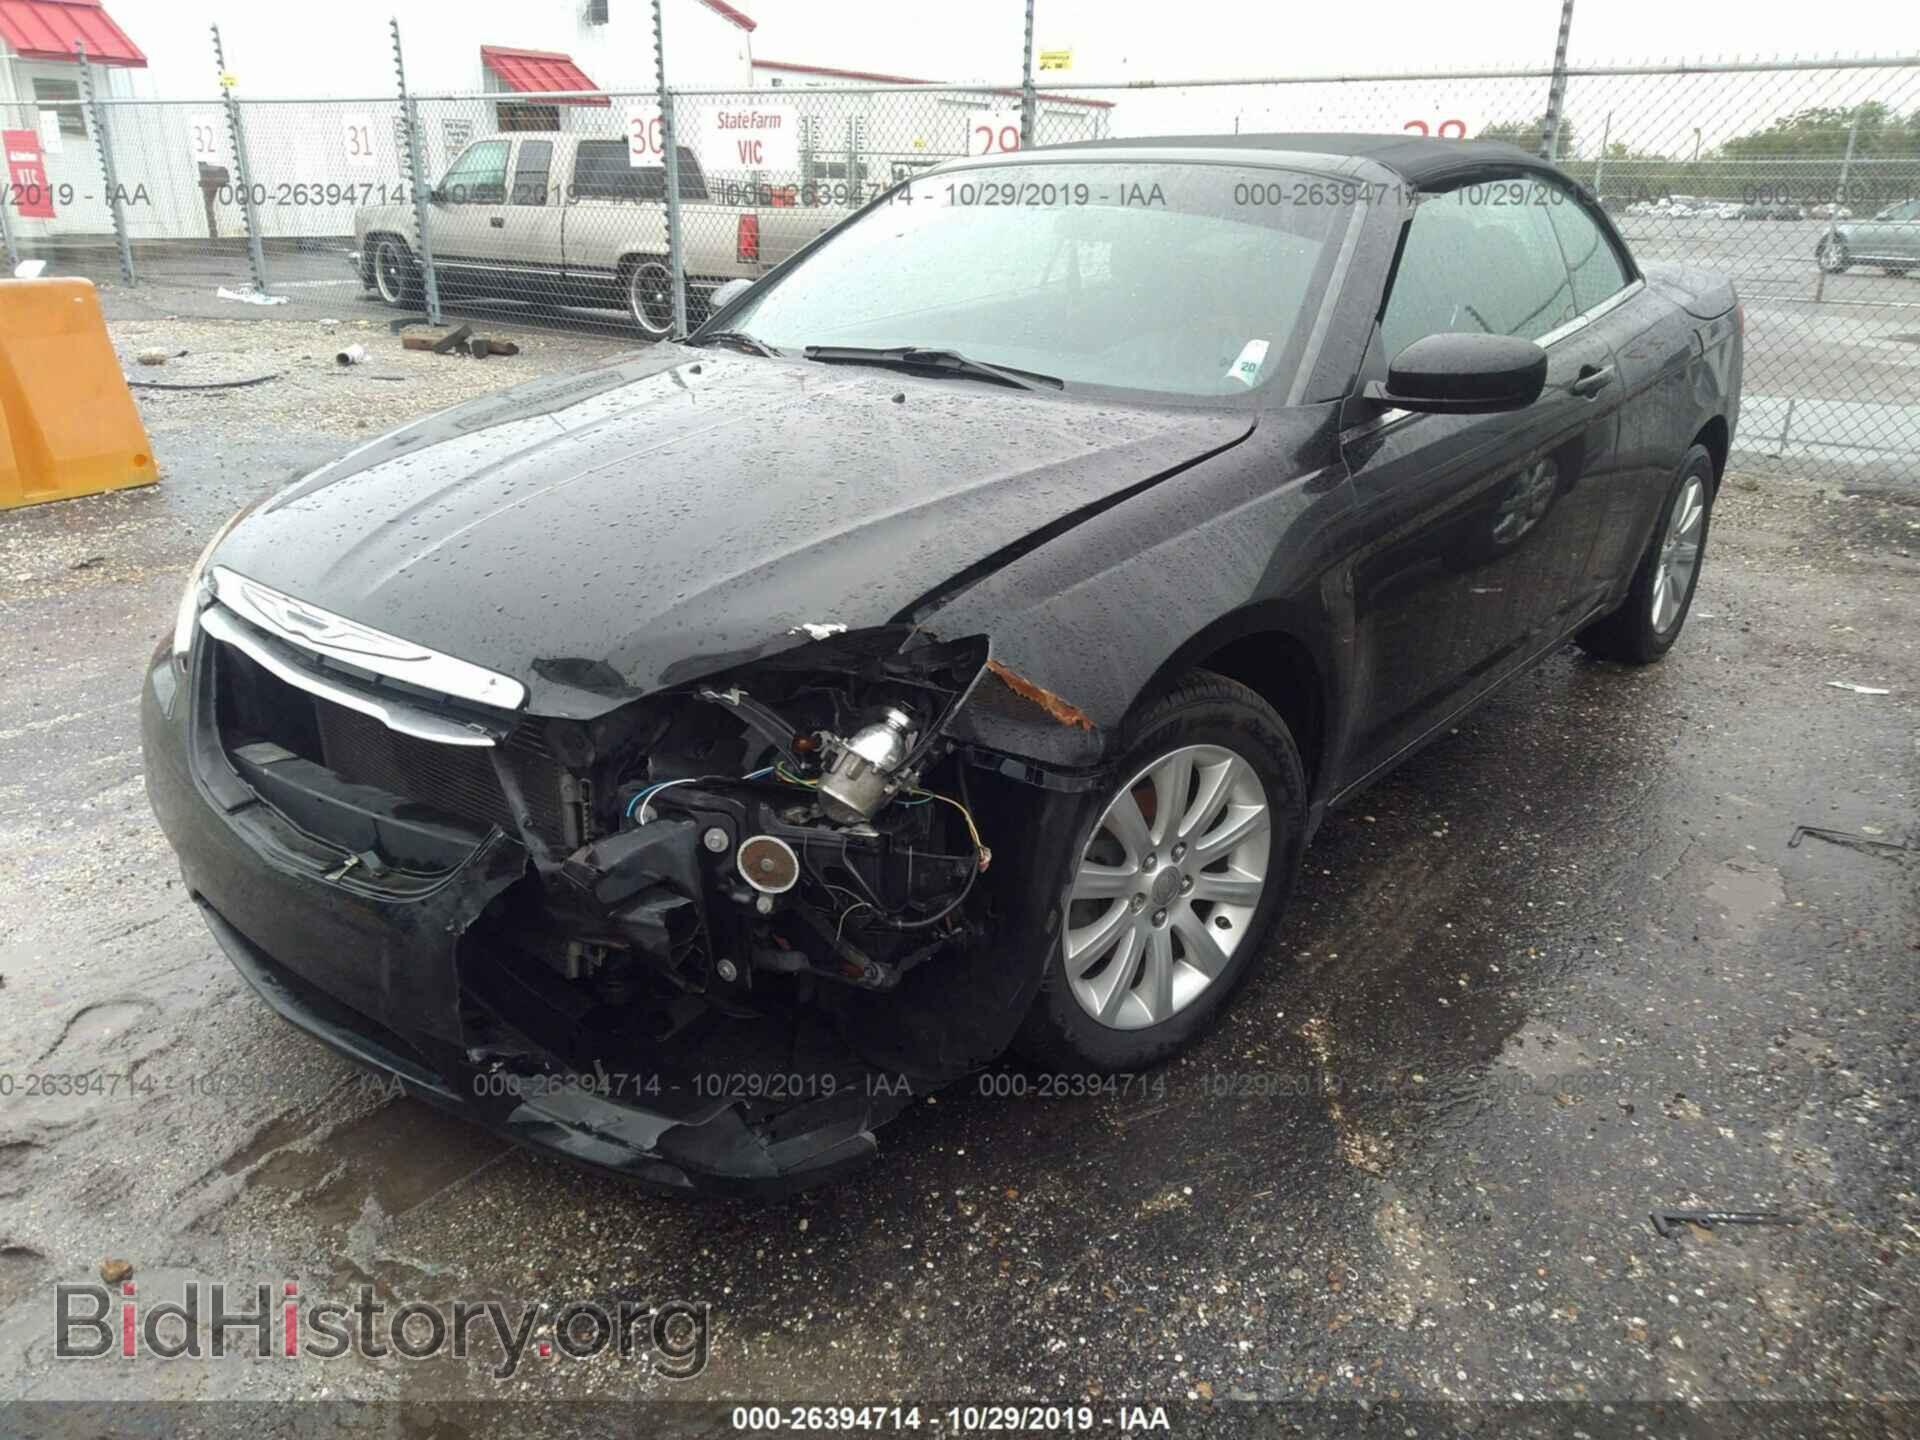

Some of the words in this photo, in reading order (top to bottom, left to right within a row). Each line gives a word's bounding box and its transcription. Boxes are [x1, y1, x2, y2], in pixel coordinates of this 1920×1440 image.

[193, 125, 216, 153] 32
[347, 125, 374, 156] 31
[738, 140, 763, 165] VIC
[1240, 361, 1256, 373] 20
